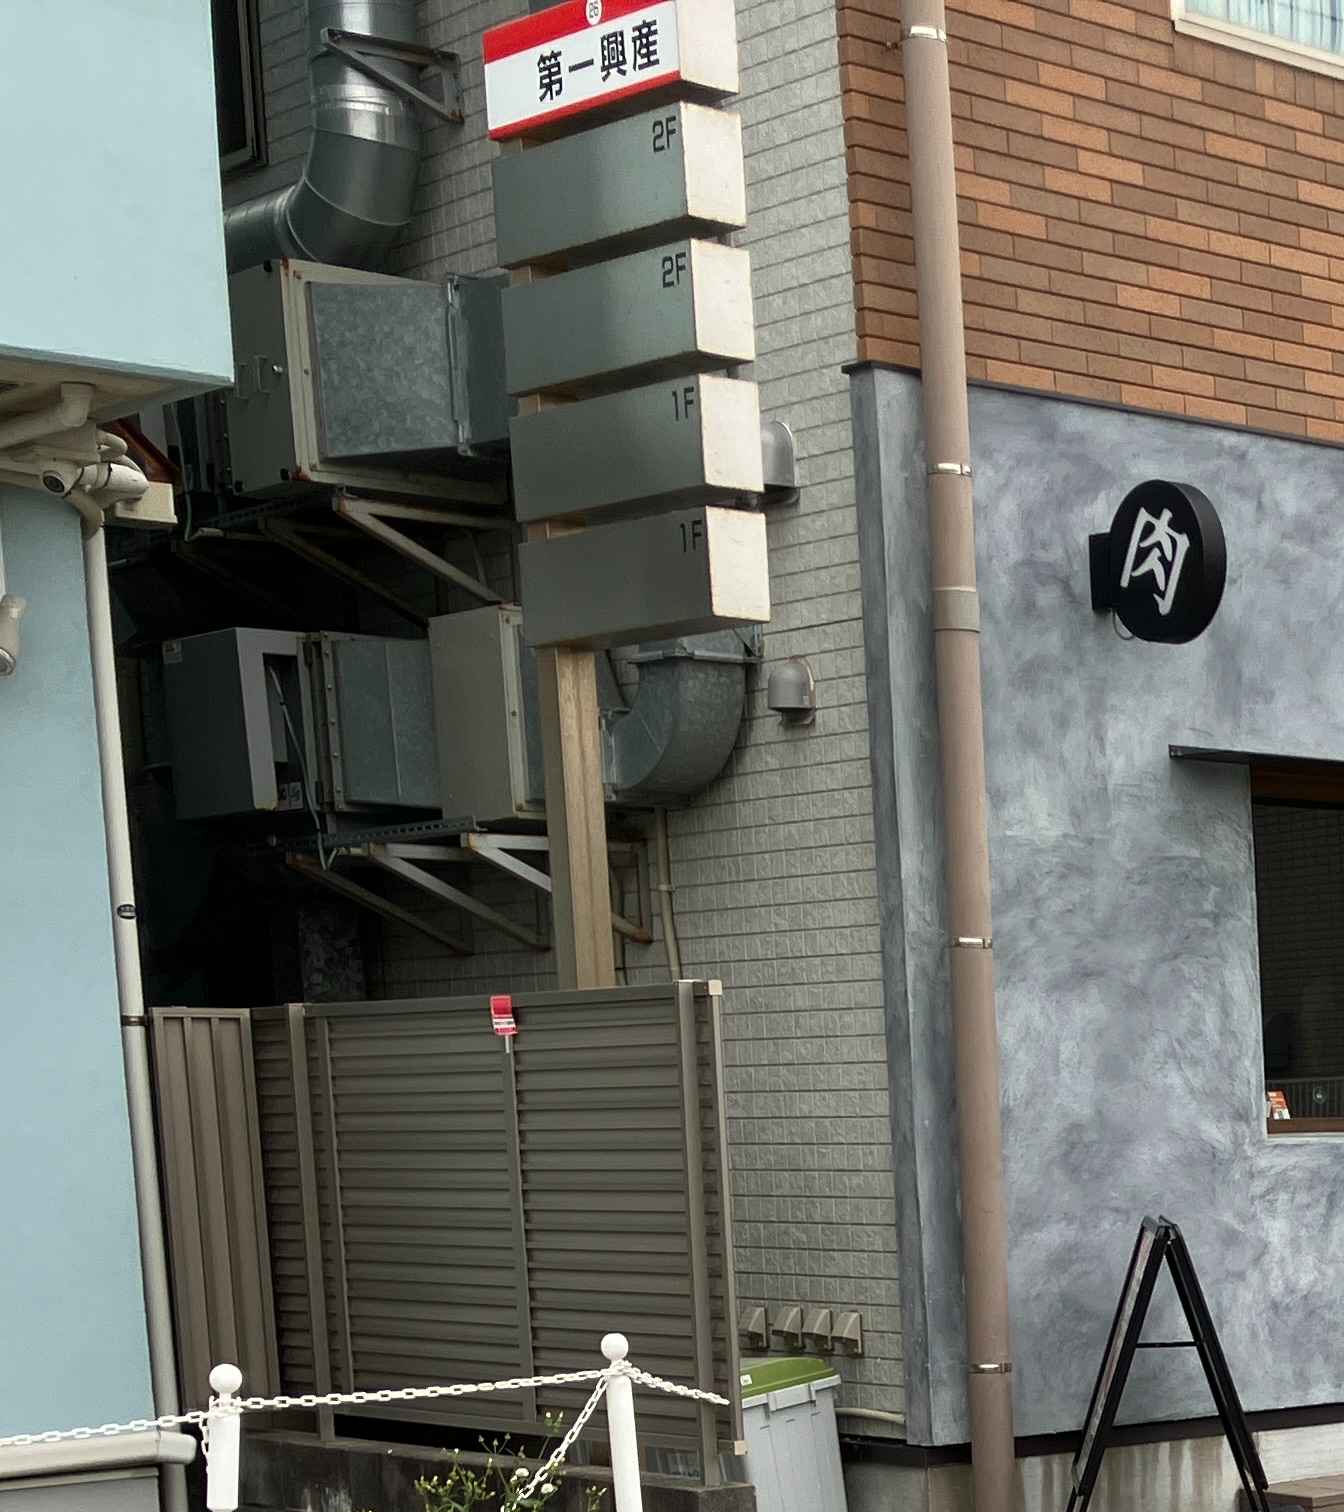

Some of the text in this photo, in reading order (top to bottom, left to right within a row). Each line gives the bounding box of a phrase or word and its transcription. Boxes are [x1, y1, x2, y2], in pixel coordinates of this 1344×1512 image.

[538, 19, 660, 102] 第一興産
[652, 115, 677, 153] 2F
[661, 253, 687, 288] 2F
[672, 386, 695, 422] 1F
[680, 518, 704, 554] 1F
[1120, 507, 1190, 616] 肉
